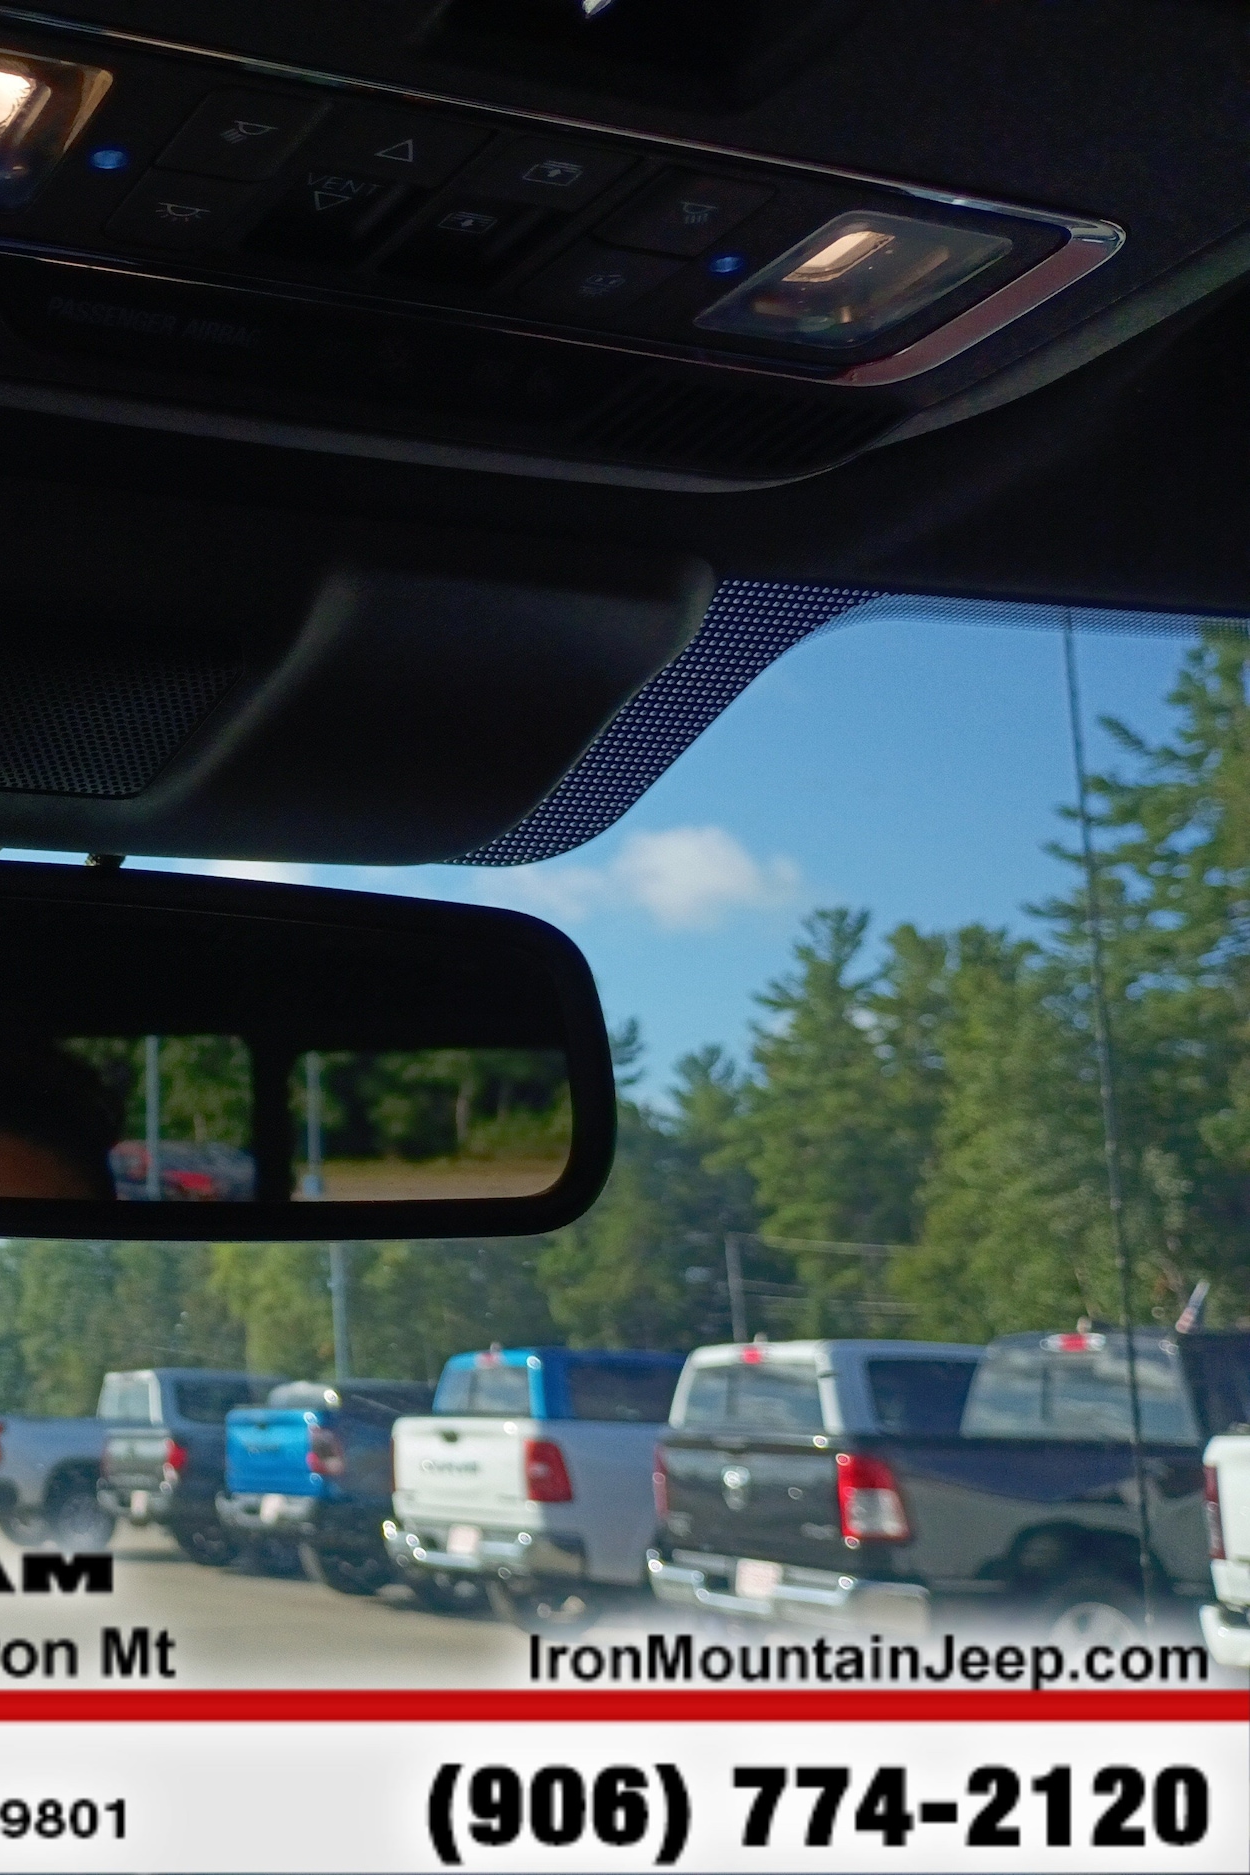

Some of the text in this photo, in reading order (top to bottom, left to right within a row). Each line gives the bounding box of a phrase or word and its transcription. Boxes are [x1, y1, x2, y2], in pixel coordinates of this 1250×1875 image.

[306, 172, 385, 197] VENT
[45, 296, 263, 348] PASSENGER AIRBAG
